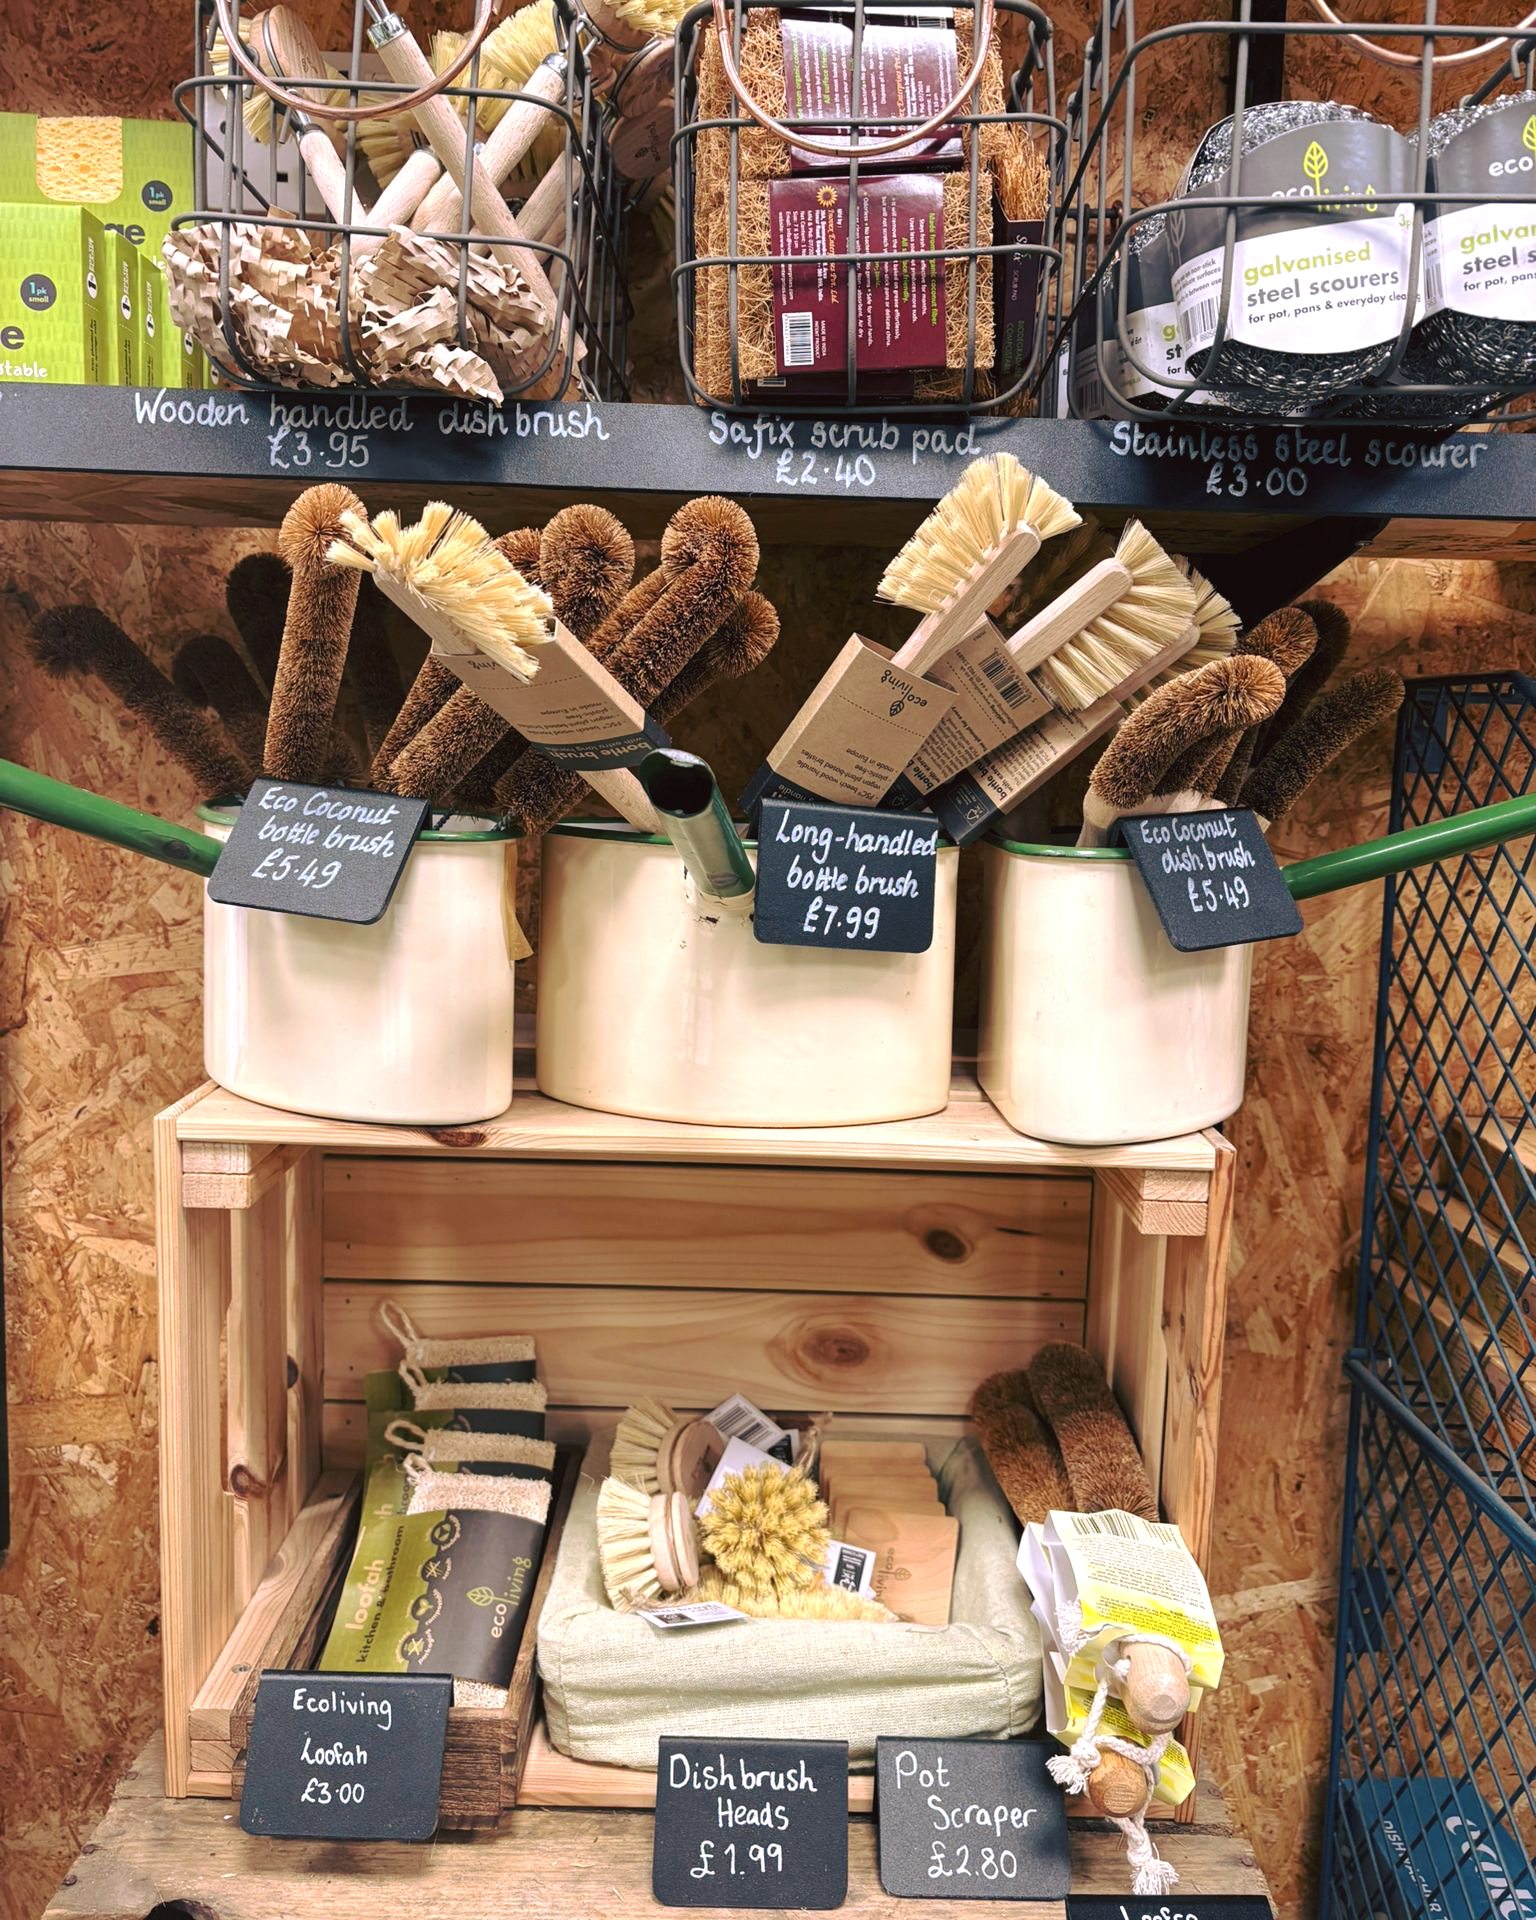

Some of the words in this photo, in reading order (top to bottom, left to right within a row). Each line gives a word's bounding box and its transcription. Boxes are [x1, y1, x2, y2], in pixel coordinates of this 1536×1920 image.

[1244, 241, 1371, 286] galvanised
[1463, 246, 1518, 275] steel
[1247, 279, 1300, 307] steel
[1309, 271, 1399, 296] scourers
[1464, 281, 1481, 292] for
[1485, 277, 1507, 290] pot,
[1248, 313, 1265, 324] for
[1269, 308, 1291, 322] pot,
[1294, 303, 1321, 317] pans
[1325, 301, 1333, 310] &
[1337, 293, 1386, 309] everyday
[135, 388, 250, 427] Wooden
[269, 392, 414, 431] handled
[267, 425, 369, 469] £3.95
[709, 411, 795, 459] Safix
[810, 416, 900, 450] scrub
[912, 423, 981, 464] pad
[1109, 421, 1259, 462] Stainless
[1276, 430, 1352, 467] steel
[1364, 441, 1488, 470] scourer
[776, 448, 876, 488] £2.40
[1206, 461, 1308, 497] £3.00
[797, 760, 820, 776] handle
[846, 748, 869, 763] Europe
[913, 766, 934, 790] bottle
[987, 774, 1007, 800] bottle
[258, 786, 299, 812] Eco
[303, 791, 400, 825] Coconut
[258, 815, 320, 846] bottle
[323, 825, 395, 858] brush
[776, 809, 938, 865] Long-handled
[1140, 819, 1171, 845] Eco
[1172, 813, 1238, 843] Coconut
[252, 848, 343, 889] £5.49
[787, 854, 849, 892] bottle
[855, 865, 920, 898] brush
[1161, 845, 1204, 874] dish
[1201, 840, 1256, 872] brush
[1187, 875, 1250, 913] £5.49
[803, 896, 881, 939] £7.99
[346, 1558, 385, 1631] loofah
[355, 1612, 382, 1664] kitchen
[382, 1524, 405, 1593] bathroom
[491, 1603, 507, 1638] eco
[504, 1556, 532, 1606] living
[292, 1687, 393, 1731] Ecoliving
[300, 1737, 368, 1766] Loofah
[895, 1750, 950, 1789] Pot
[301, 1777, 365, 1804] £3.00
[717, 1796, 789, 1831] Heads
[927, 1794, 1038, 1837] Scraper
[690, 1840, 783, 1879] £1.99
[927, 1840, 1018, 1880] £2.80
